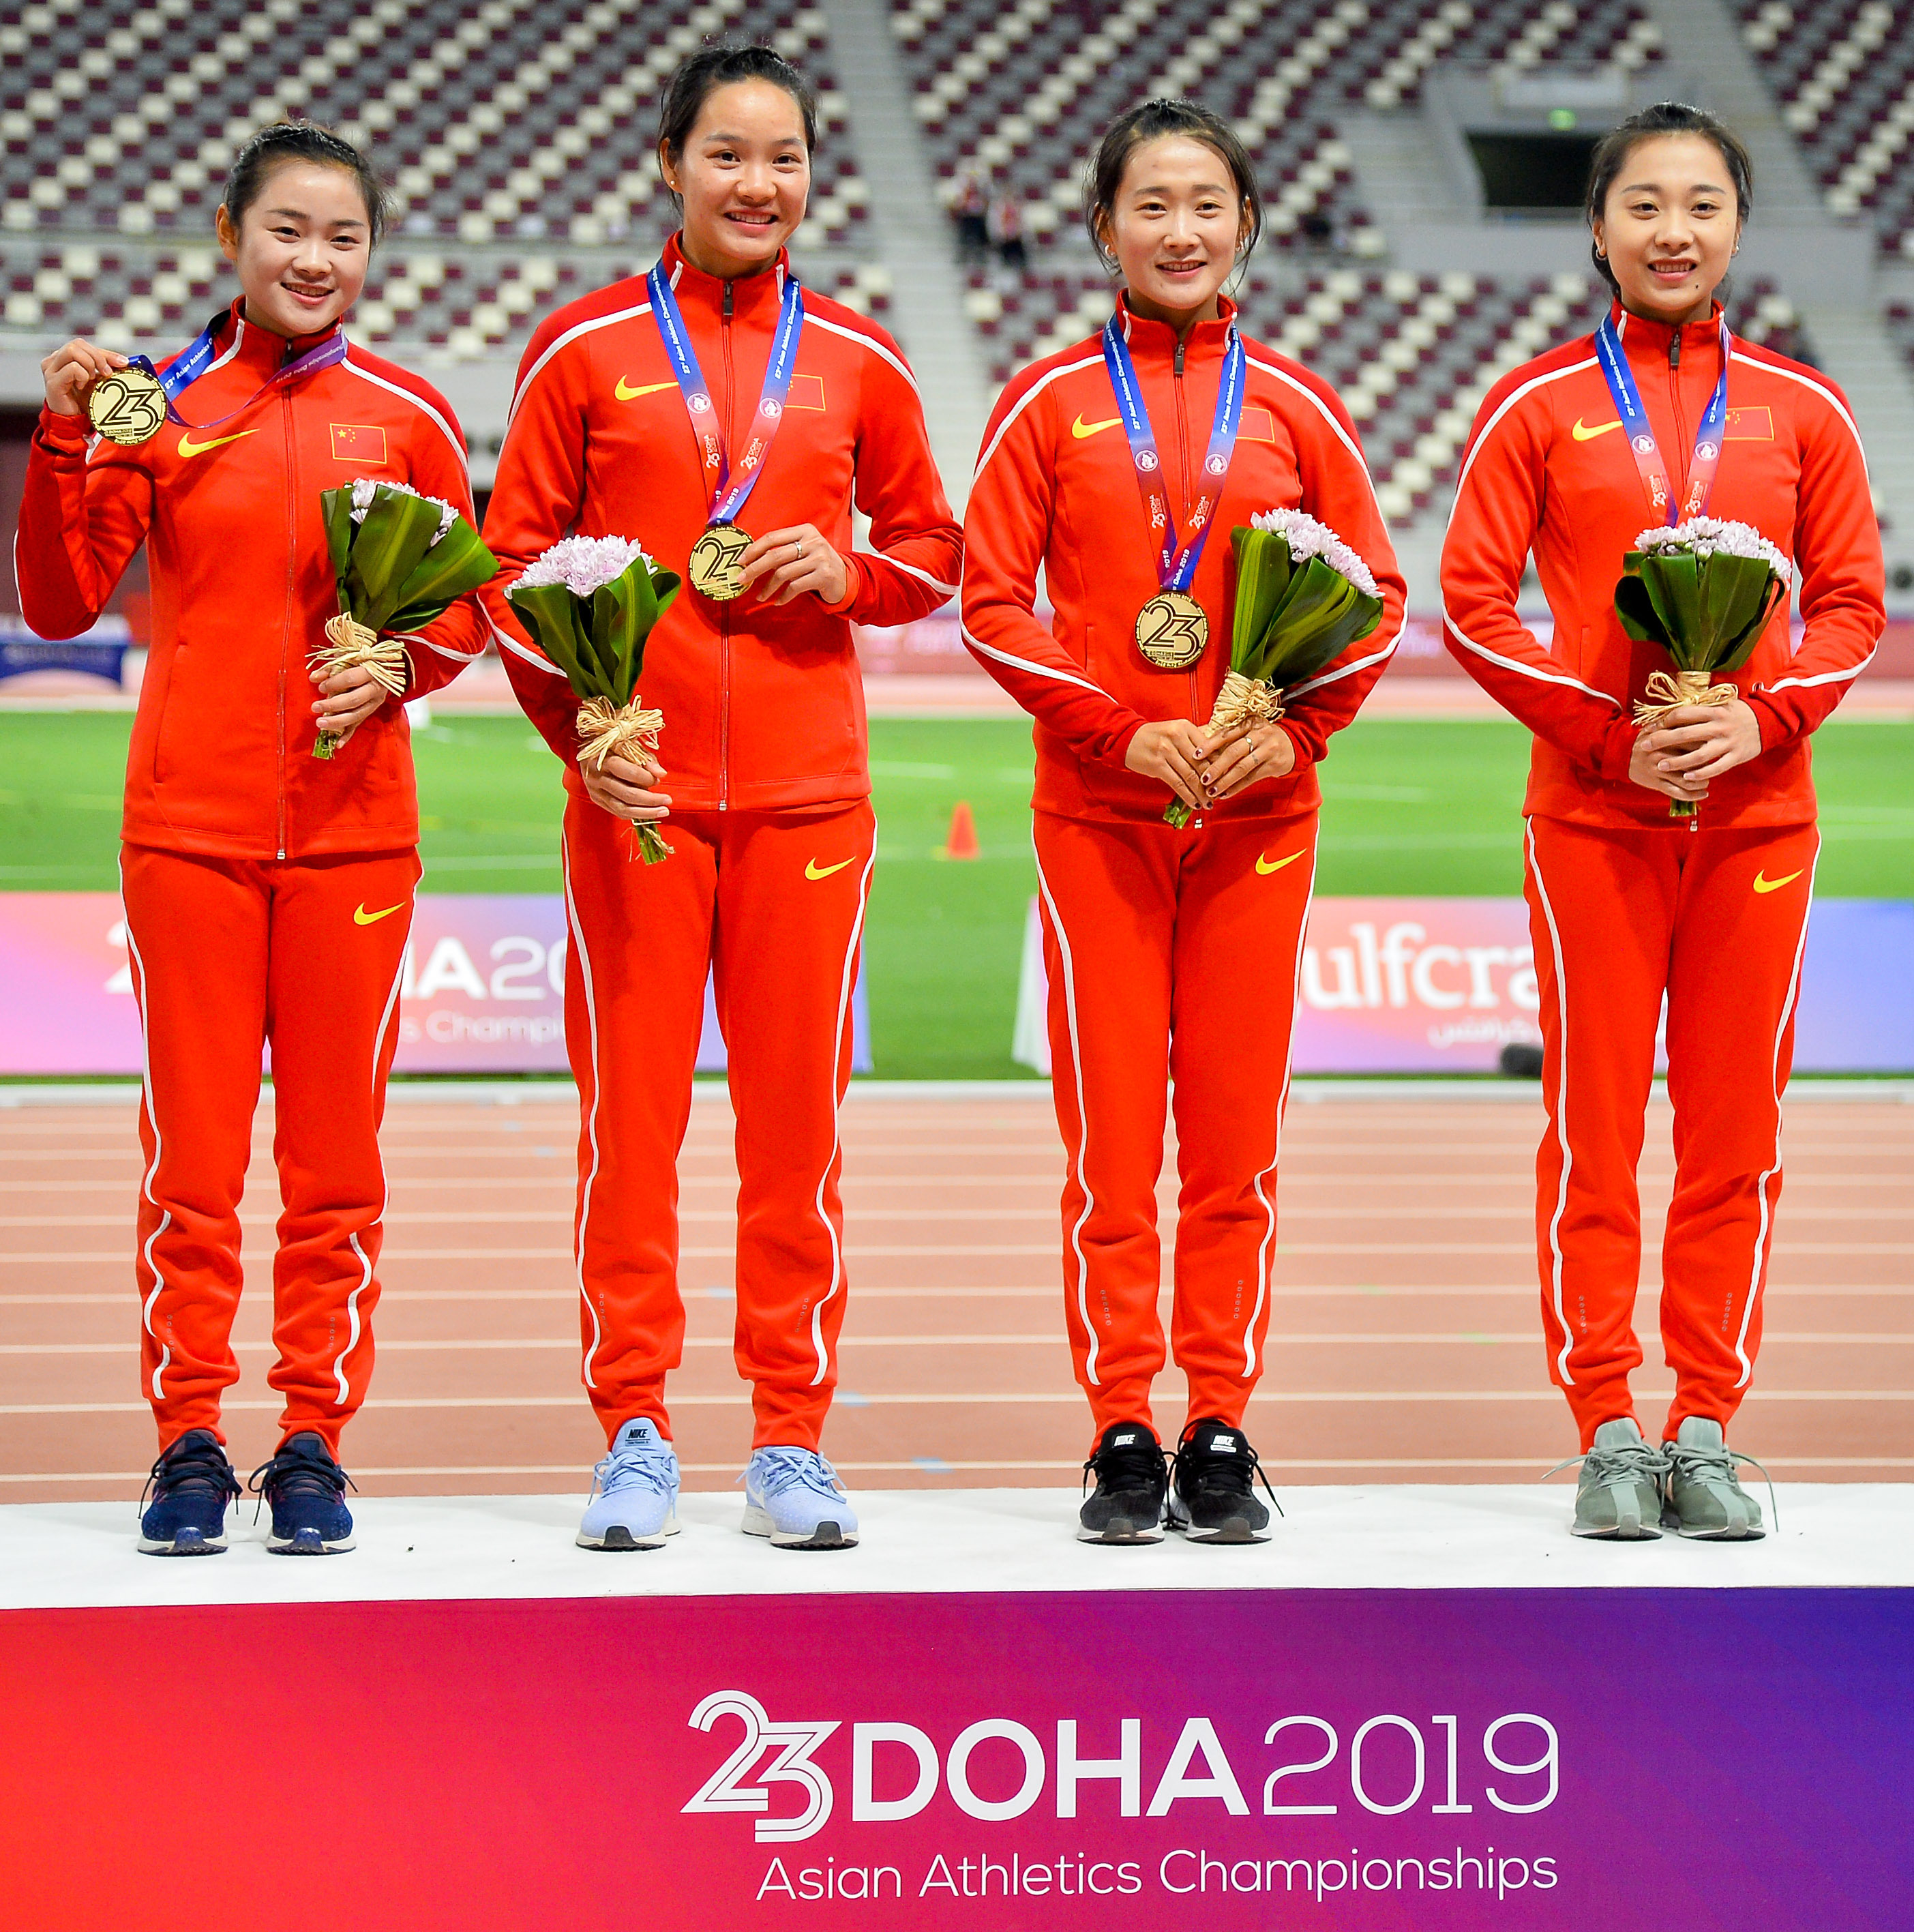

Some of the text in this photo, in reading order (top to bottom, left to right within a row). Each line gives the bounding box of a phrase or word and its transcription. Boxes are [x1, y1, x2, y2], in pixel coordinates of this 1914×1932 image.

[175, 363, 191, 379] Asian
[190, 344, 210, 366] Athletics
[1179, 549, 1190, 568] 2019
[627, 1428, 648, 1439] NIKE
[1113, 1434, 1136, 1446] NIKE
[680, 1690, 843, 1843] 23
[756, 1847, 1558, 1903] Asian Athletics Championships
